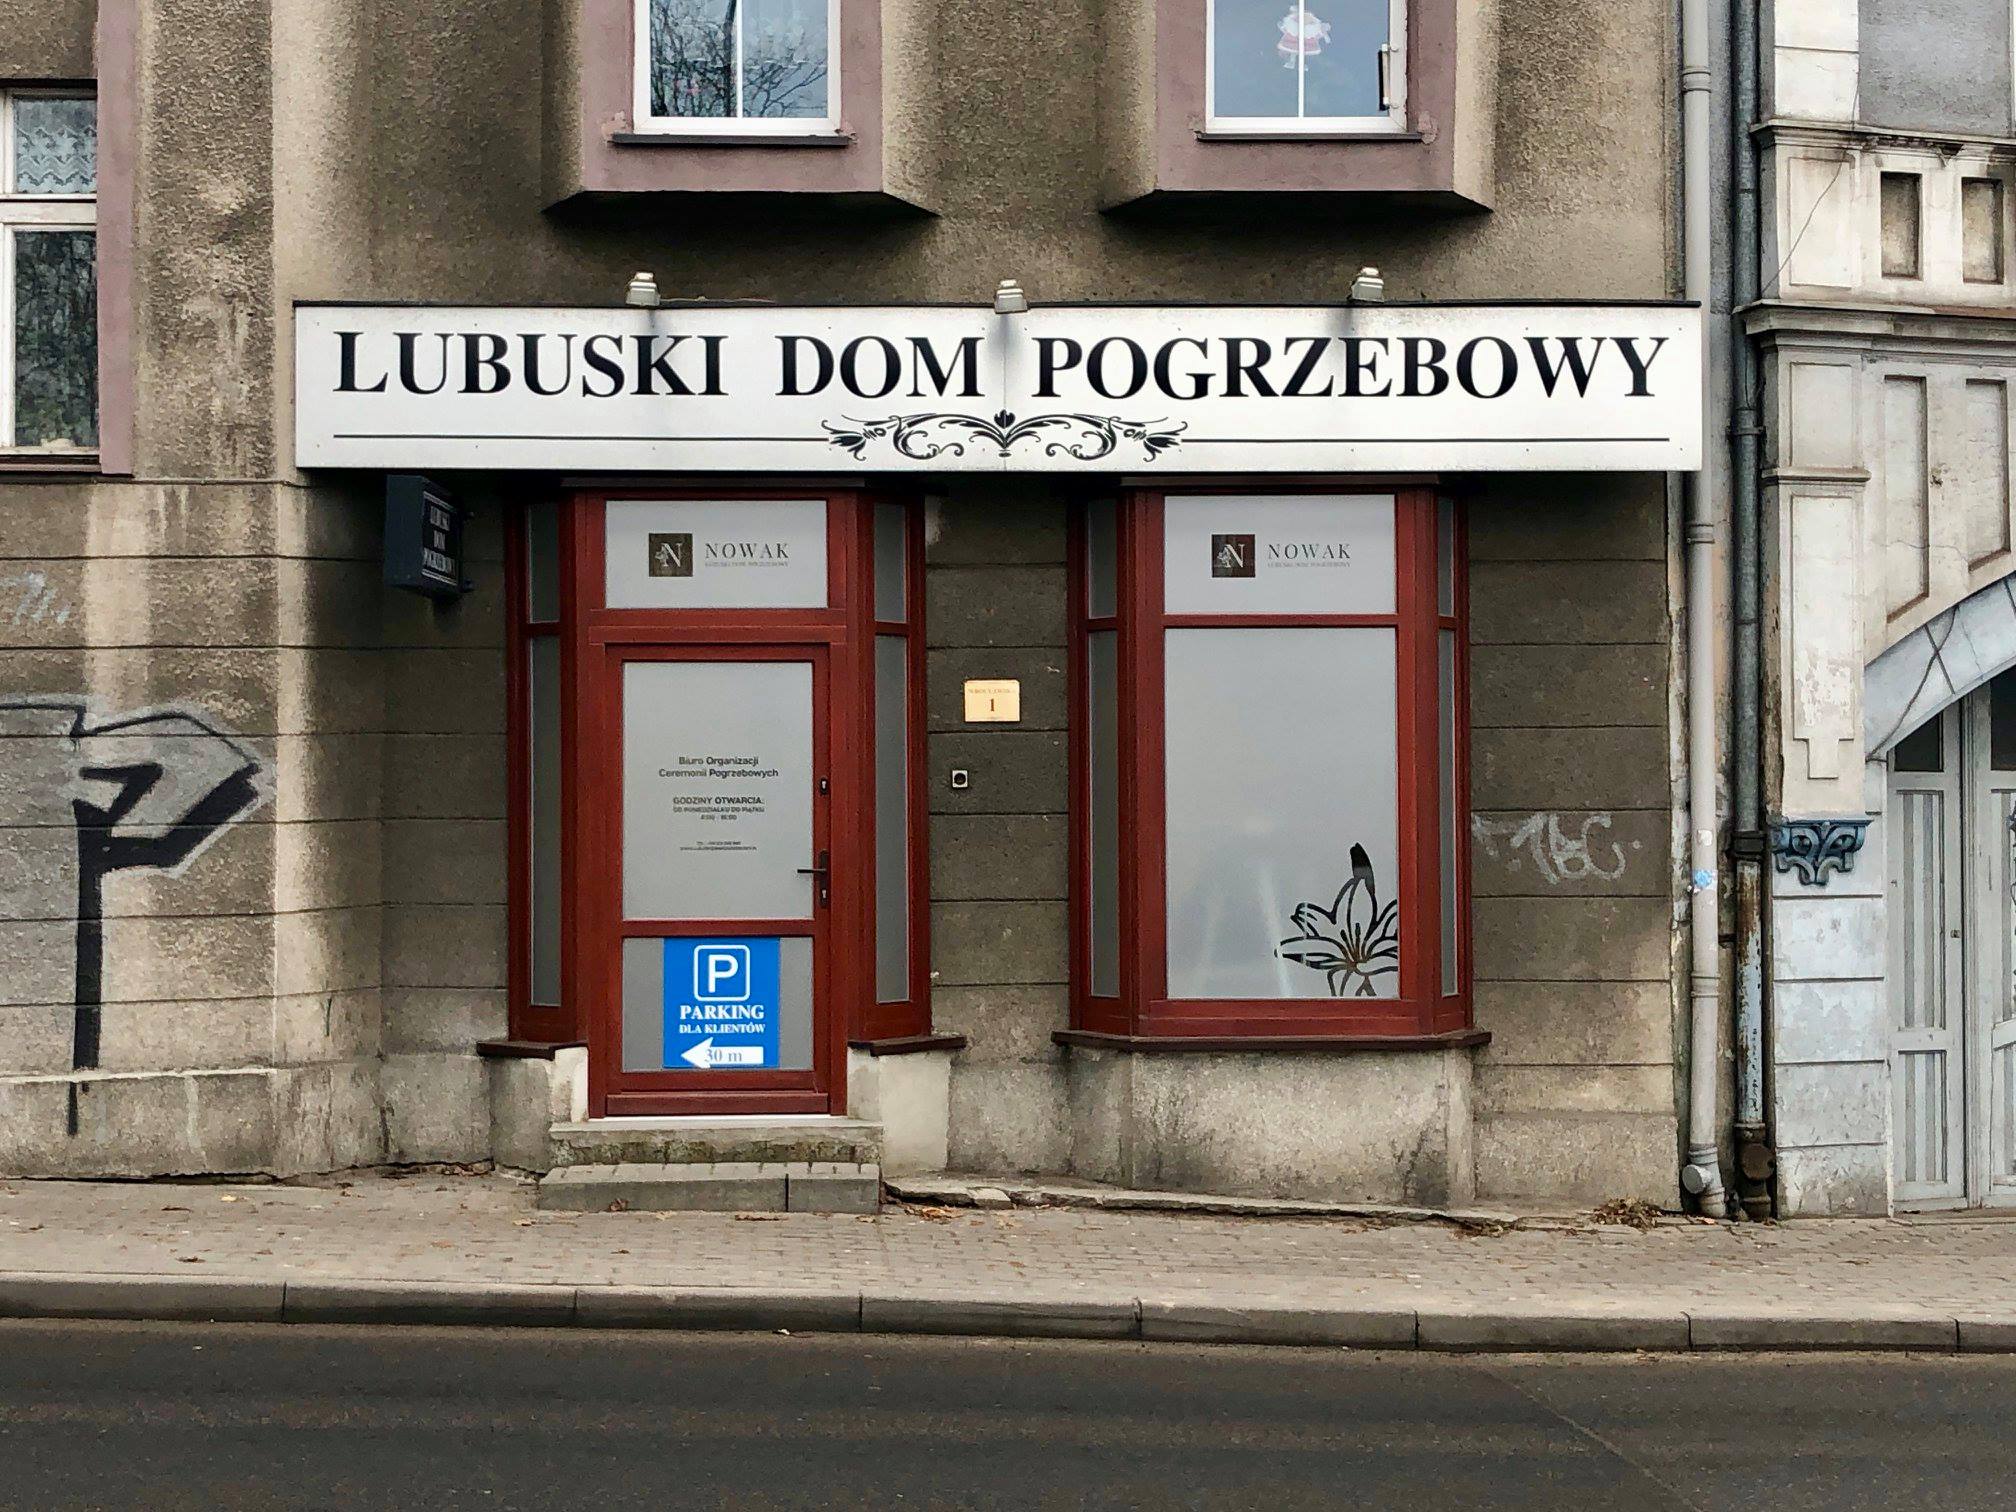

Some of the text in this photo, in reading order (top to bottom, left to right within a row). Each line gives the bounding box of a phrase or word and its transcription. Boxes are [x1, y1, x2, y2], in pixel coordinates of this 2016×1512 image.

[331, 331, 1670, 401] LUBUSKI DOM POGRZEBOWY
[704, 542, 789, 559] NOWAK
[1267, 543, 1351, 560] NOWAK
[678, 756, 759, 767] Biuro Organizacji
[658, 768, 779, 779] Ceremonii Pogrzebowych
[672, 796, 713, 805] GODZINY
[708, 954, 739, 993] P
[680, 1004, 765, 1020] PARKING
[679, 1022, 766, 1034] DLA KLIENTÓW
[704, 1048, 743, 1062] 30 m
